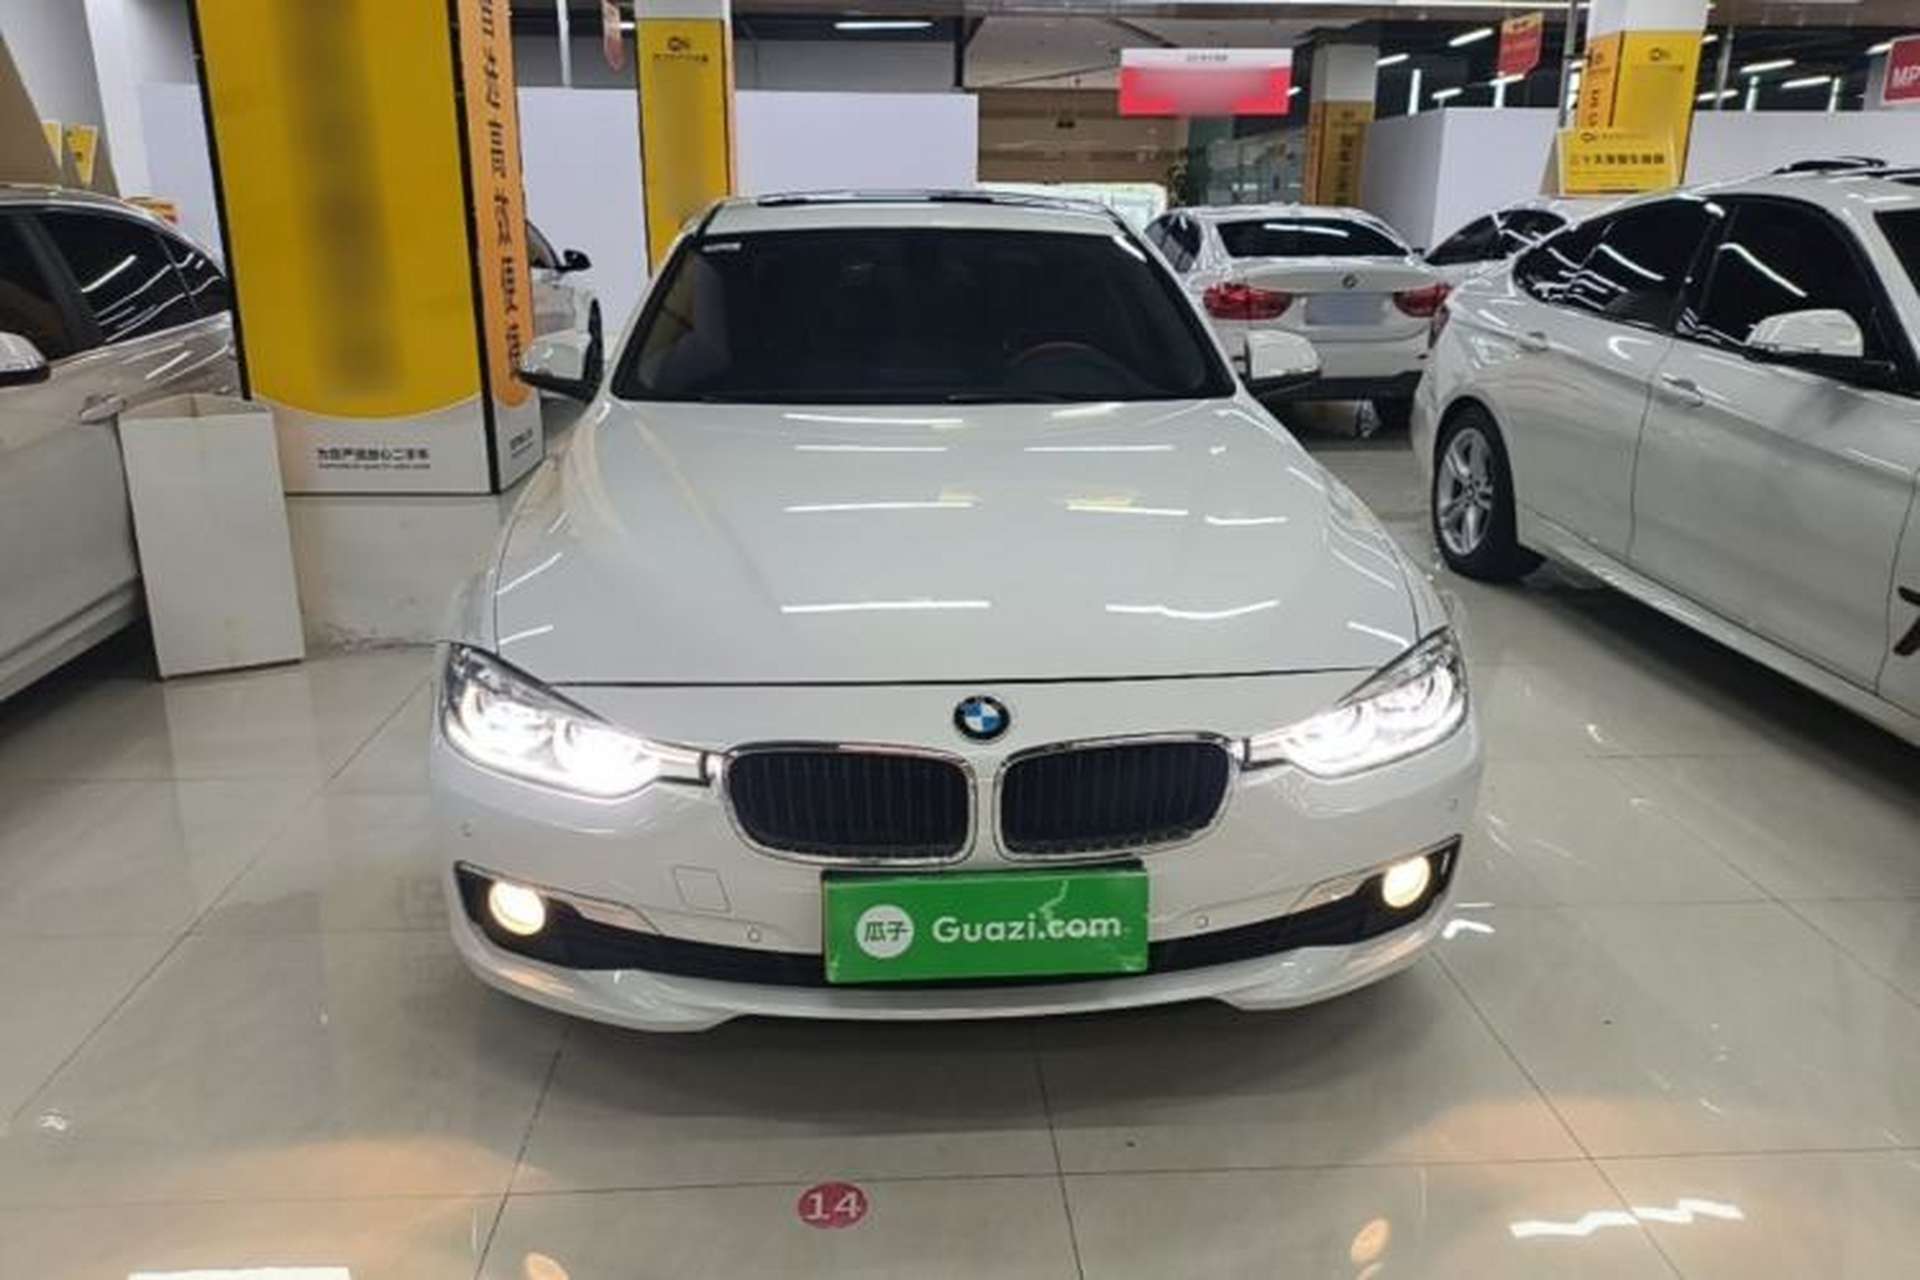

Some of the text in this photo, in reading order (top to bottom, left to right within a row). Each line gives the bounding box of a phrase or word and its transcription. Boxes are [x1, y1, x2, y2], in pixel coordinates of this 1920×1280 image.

[864, 912, 1122, 944] 瓜子 Guazi.com
[808, 1191, 861, 1220] 14
